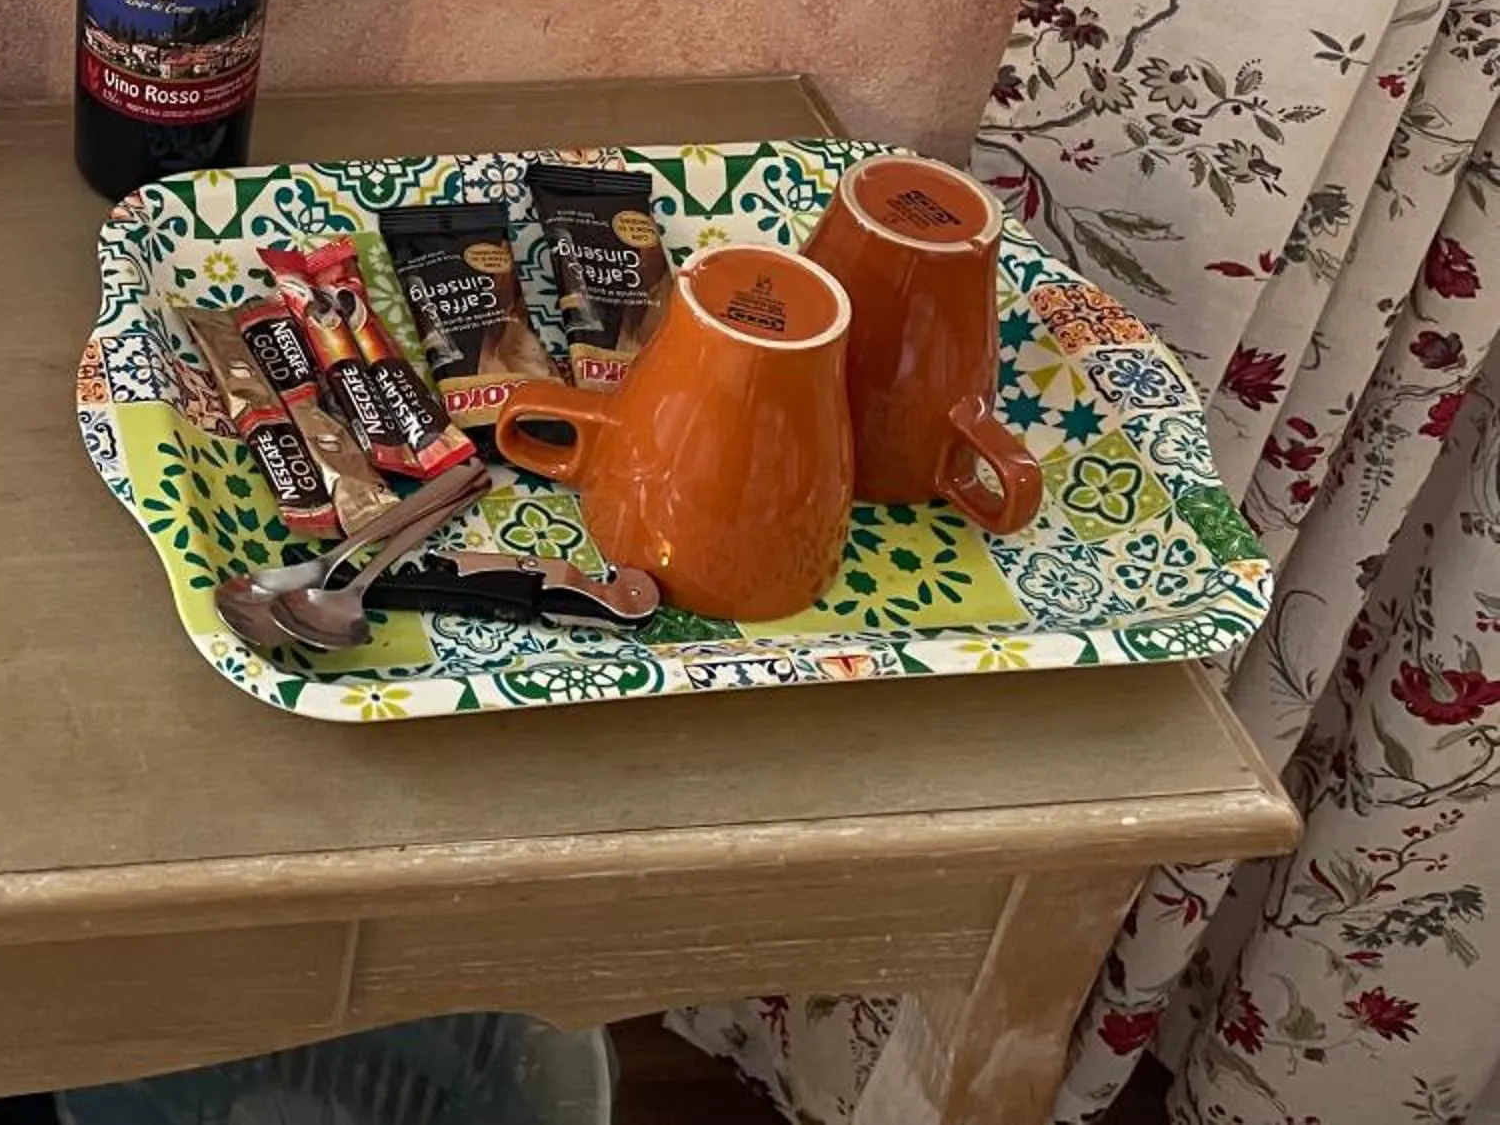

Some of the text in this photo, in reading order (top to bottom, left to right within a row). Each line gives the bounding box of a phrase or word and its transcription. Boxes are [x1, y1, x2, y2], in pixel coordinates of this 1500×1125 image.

[103, 68, 139, 97] Vino
[144, 84, 201, 104] Rosso
[557, 237, 641, 268] Ginseng
[409, 275, 496, 302] Ginseng
[253, 334, 290, 381] GOLD
[393, 368, 433, 424] CLASSIC
[279, 434, 317, 492] GOLD
